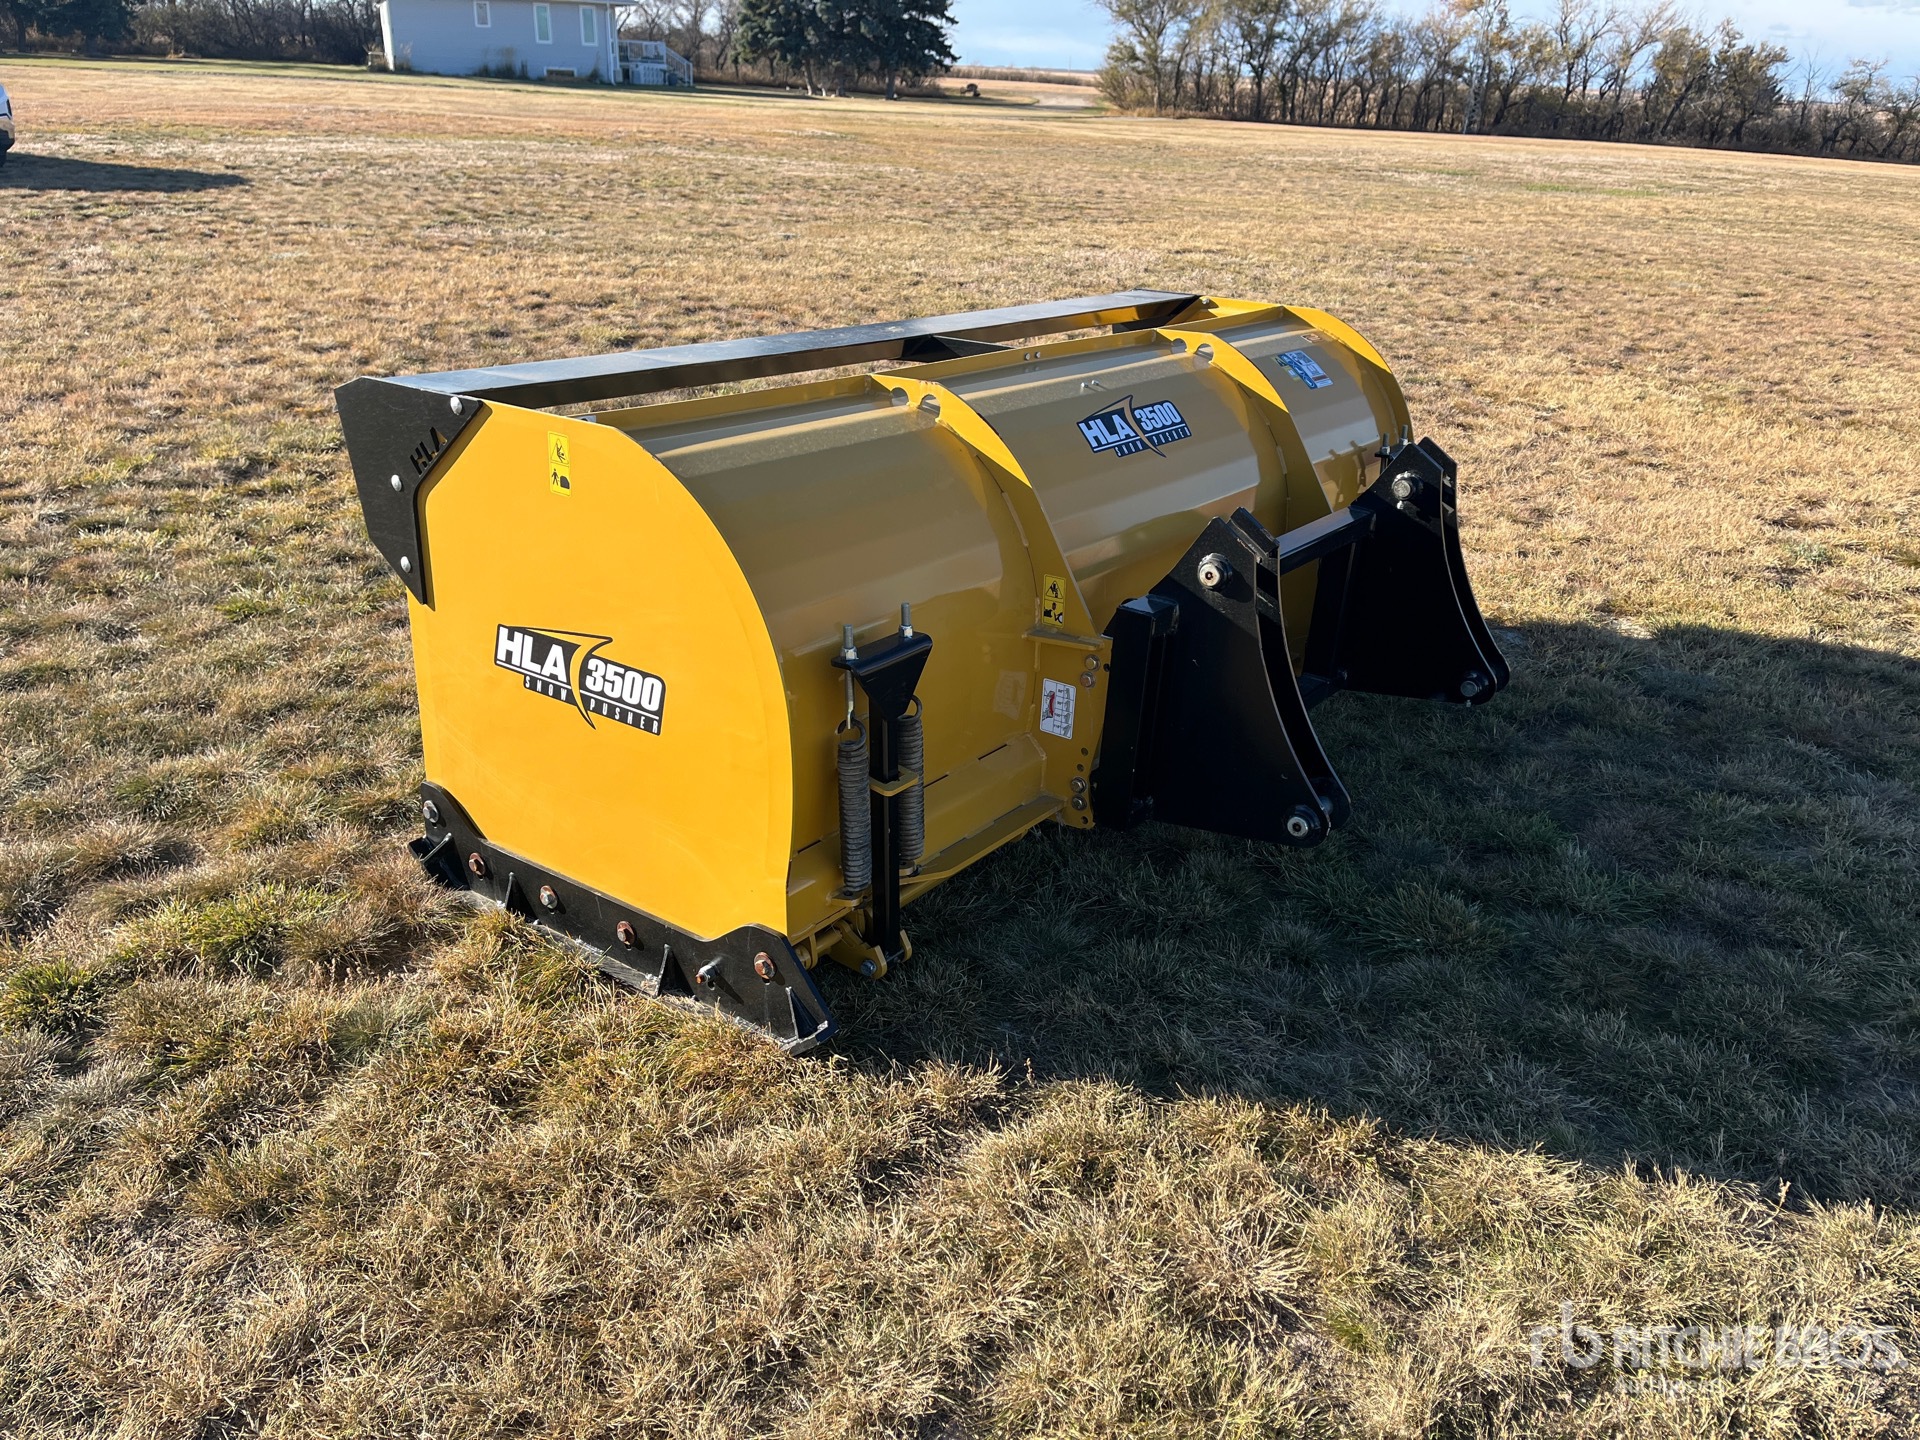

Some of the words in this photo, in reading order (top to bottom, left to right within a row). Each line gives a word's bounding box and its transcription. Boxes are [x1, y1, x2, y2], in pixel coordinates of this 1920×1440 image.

[1079, 414, 1136, 448] HLA
[1134, 402, 1182, 431] 3500
[496, 626, 568, 683] HLA
[585, 658, 663, 712] 3500
[525, 675, 568, 702] SNOW
[589, 698, 659, 734] PUSHER
